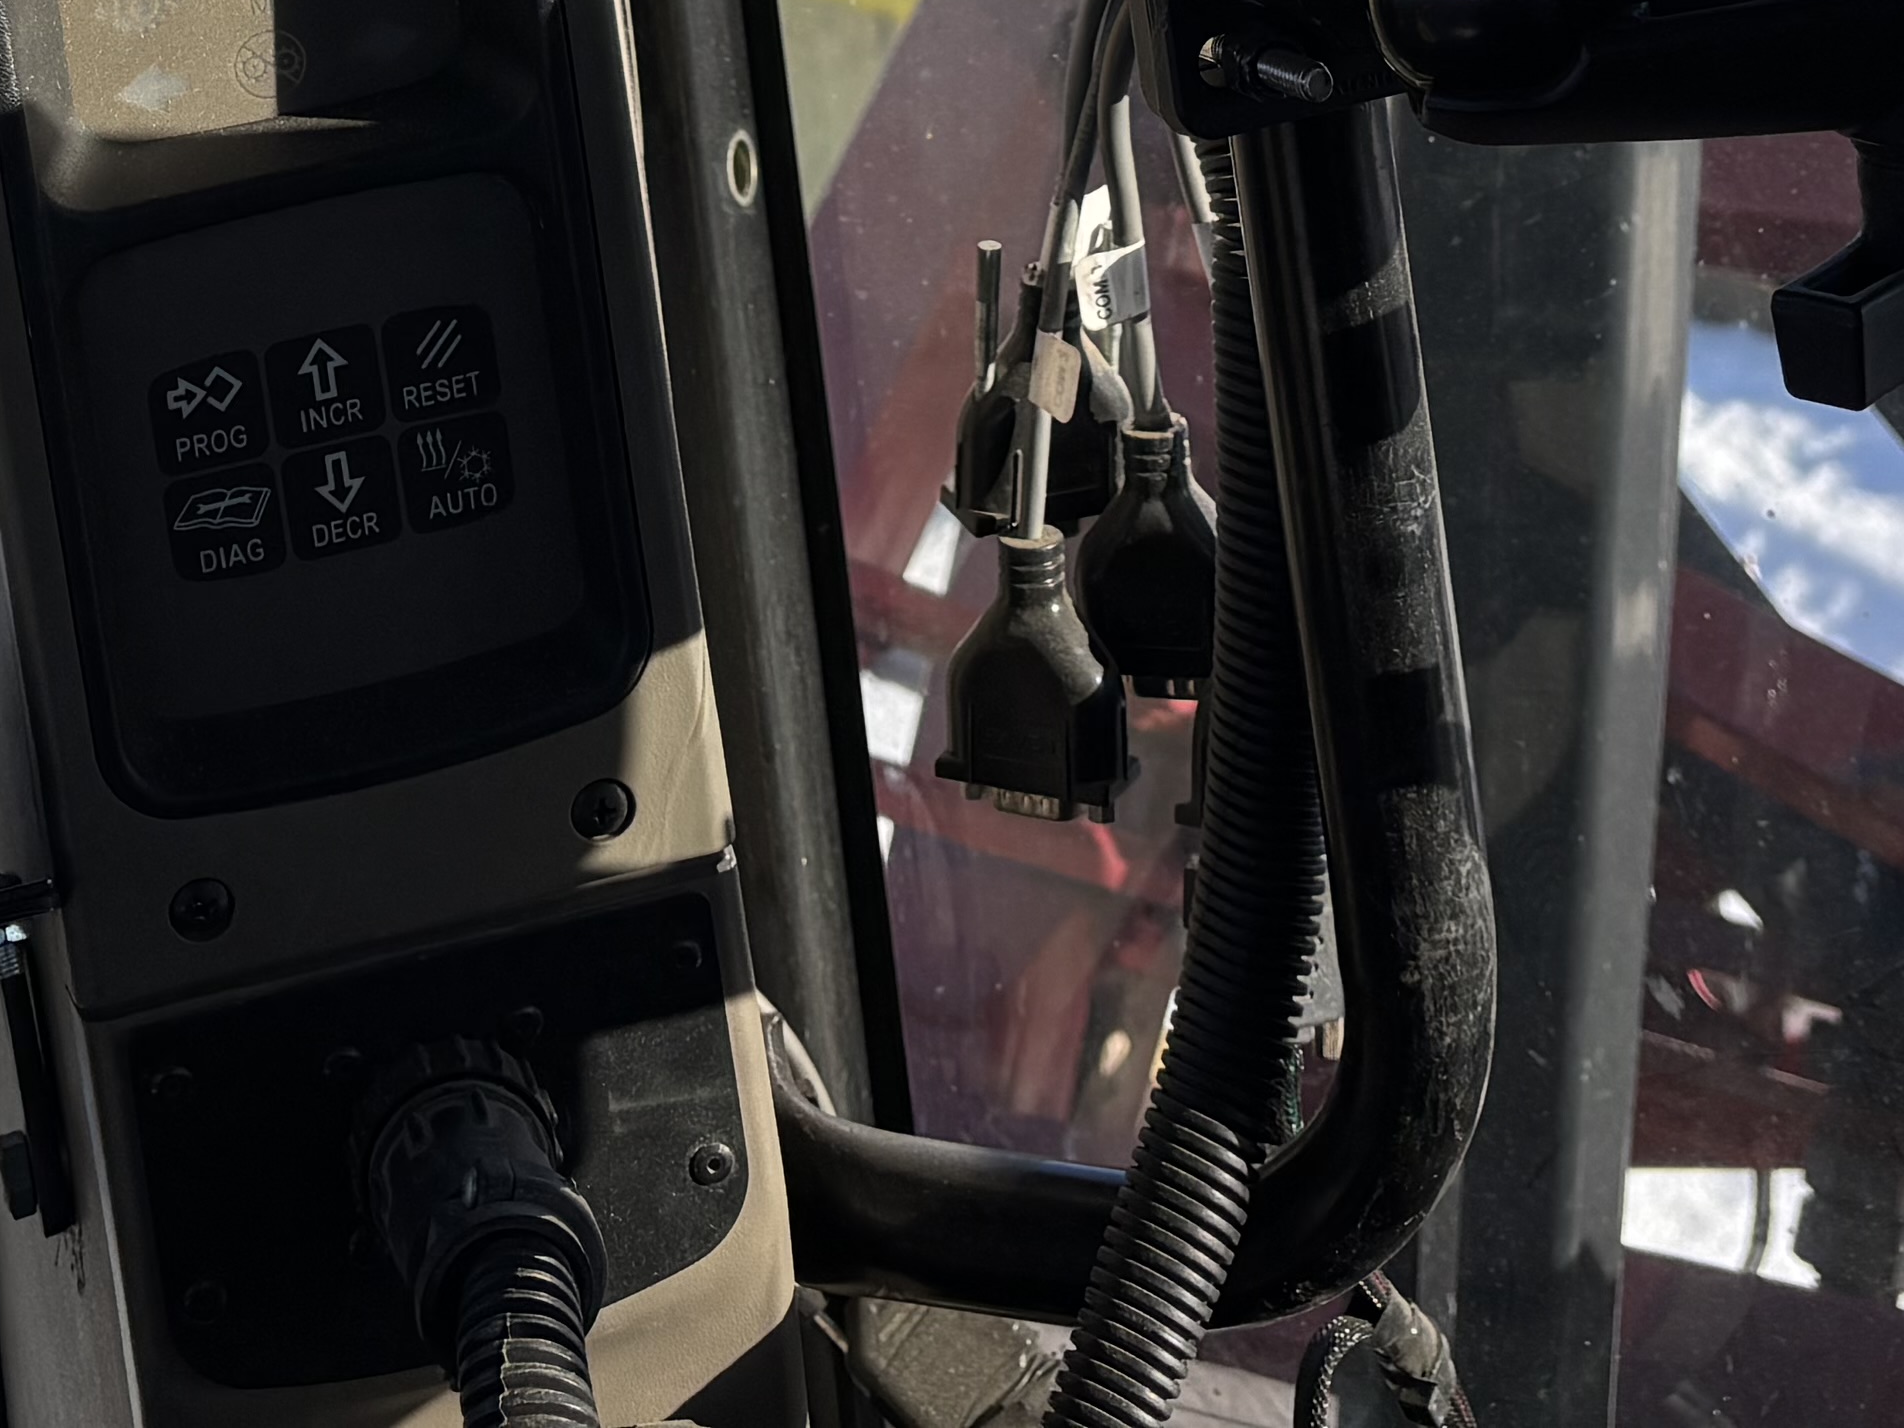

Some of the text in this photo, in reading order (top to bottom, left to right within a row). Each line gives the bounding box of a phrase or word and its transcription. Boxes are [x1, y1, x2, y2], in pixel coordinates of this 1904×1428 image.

[402, 370, 482, 410] RESET
[299, 398, 365, 433] INCR
[175, 424, 249, 462] PROG
[428, 482, 498, 520] AUTO
[311, 511, 381, 548] DECR
[199, 538, 266, 574] DIAG
